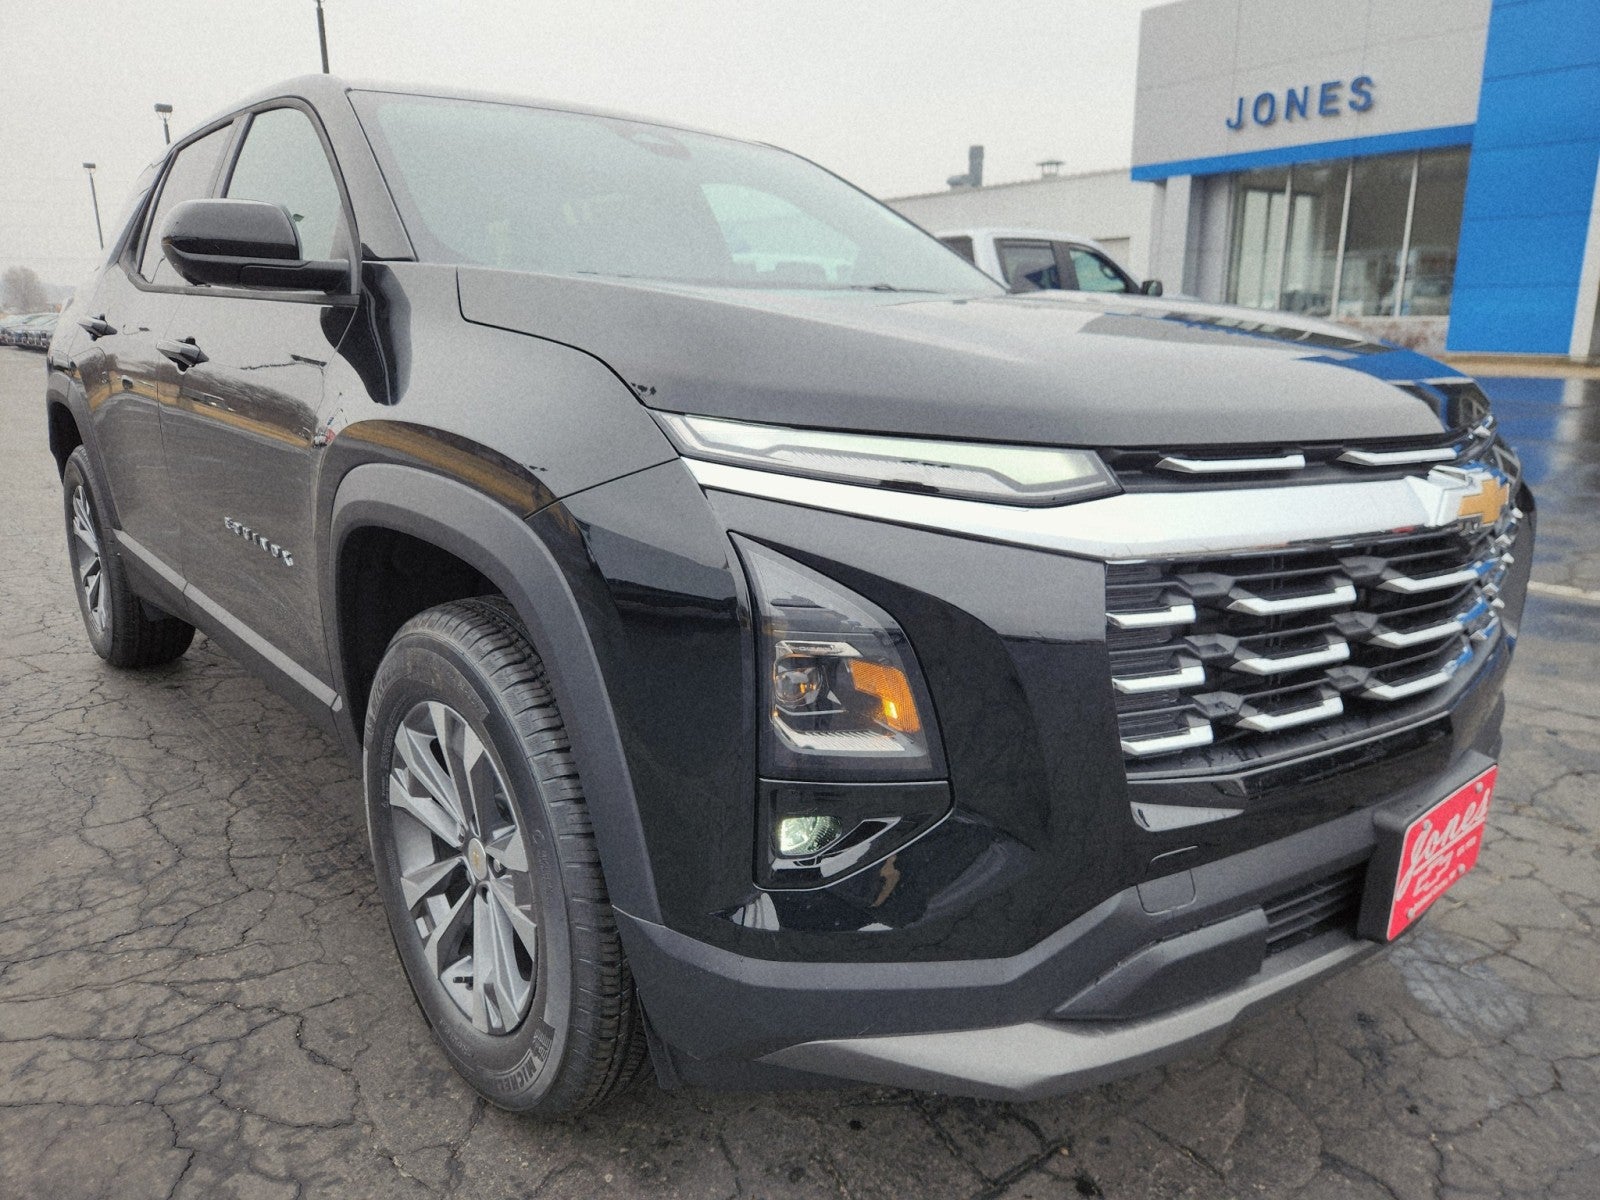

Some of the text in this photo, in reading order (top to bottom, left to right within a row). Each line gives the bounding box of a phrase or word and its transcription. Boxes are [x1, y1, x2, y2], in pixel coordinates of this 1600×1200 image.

[1225, 74, 1374, 130] JONES
[1395, 788, 1490, 901] Jones
[488, 1056, 538, 1093] MICHEL
